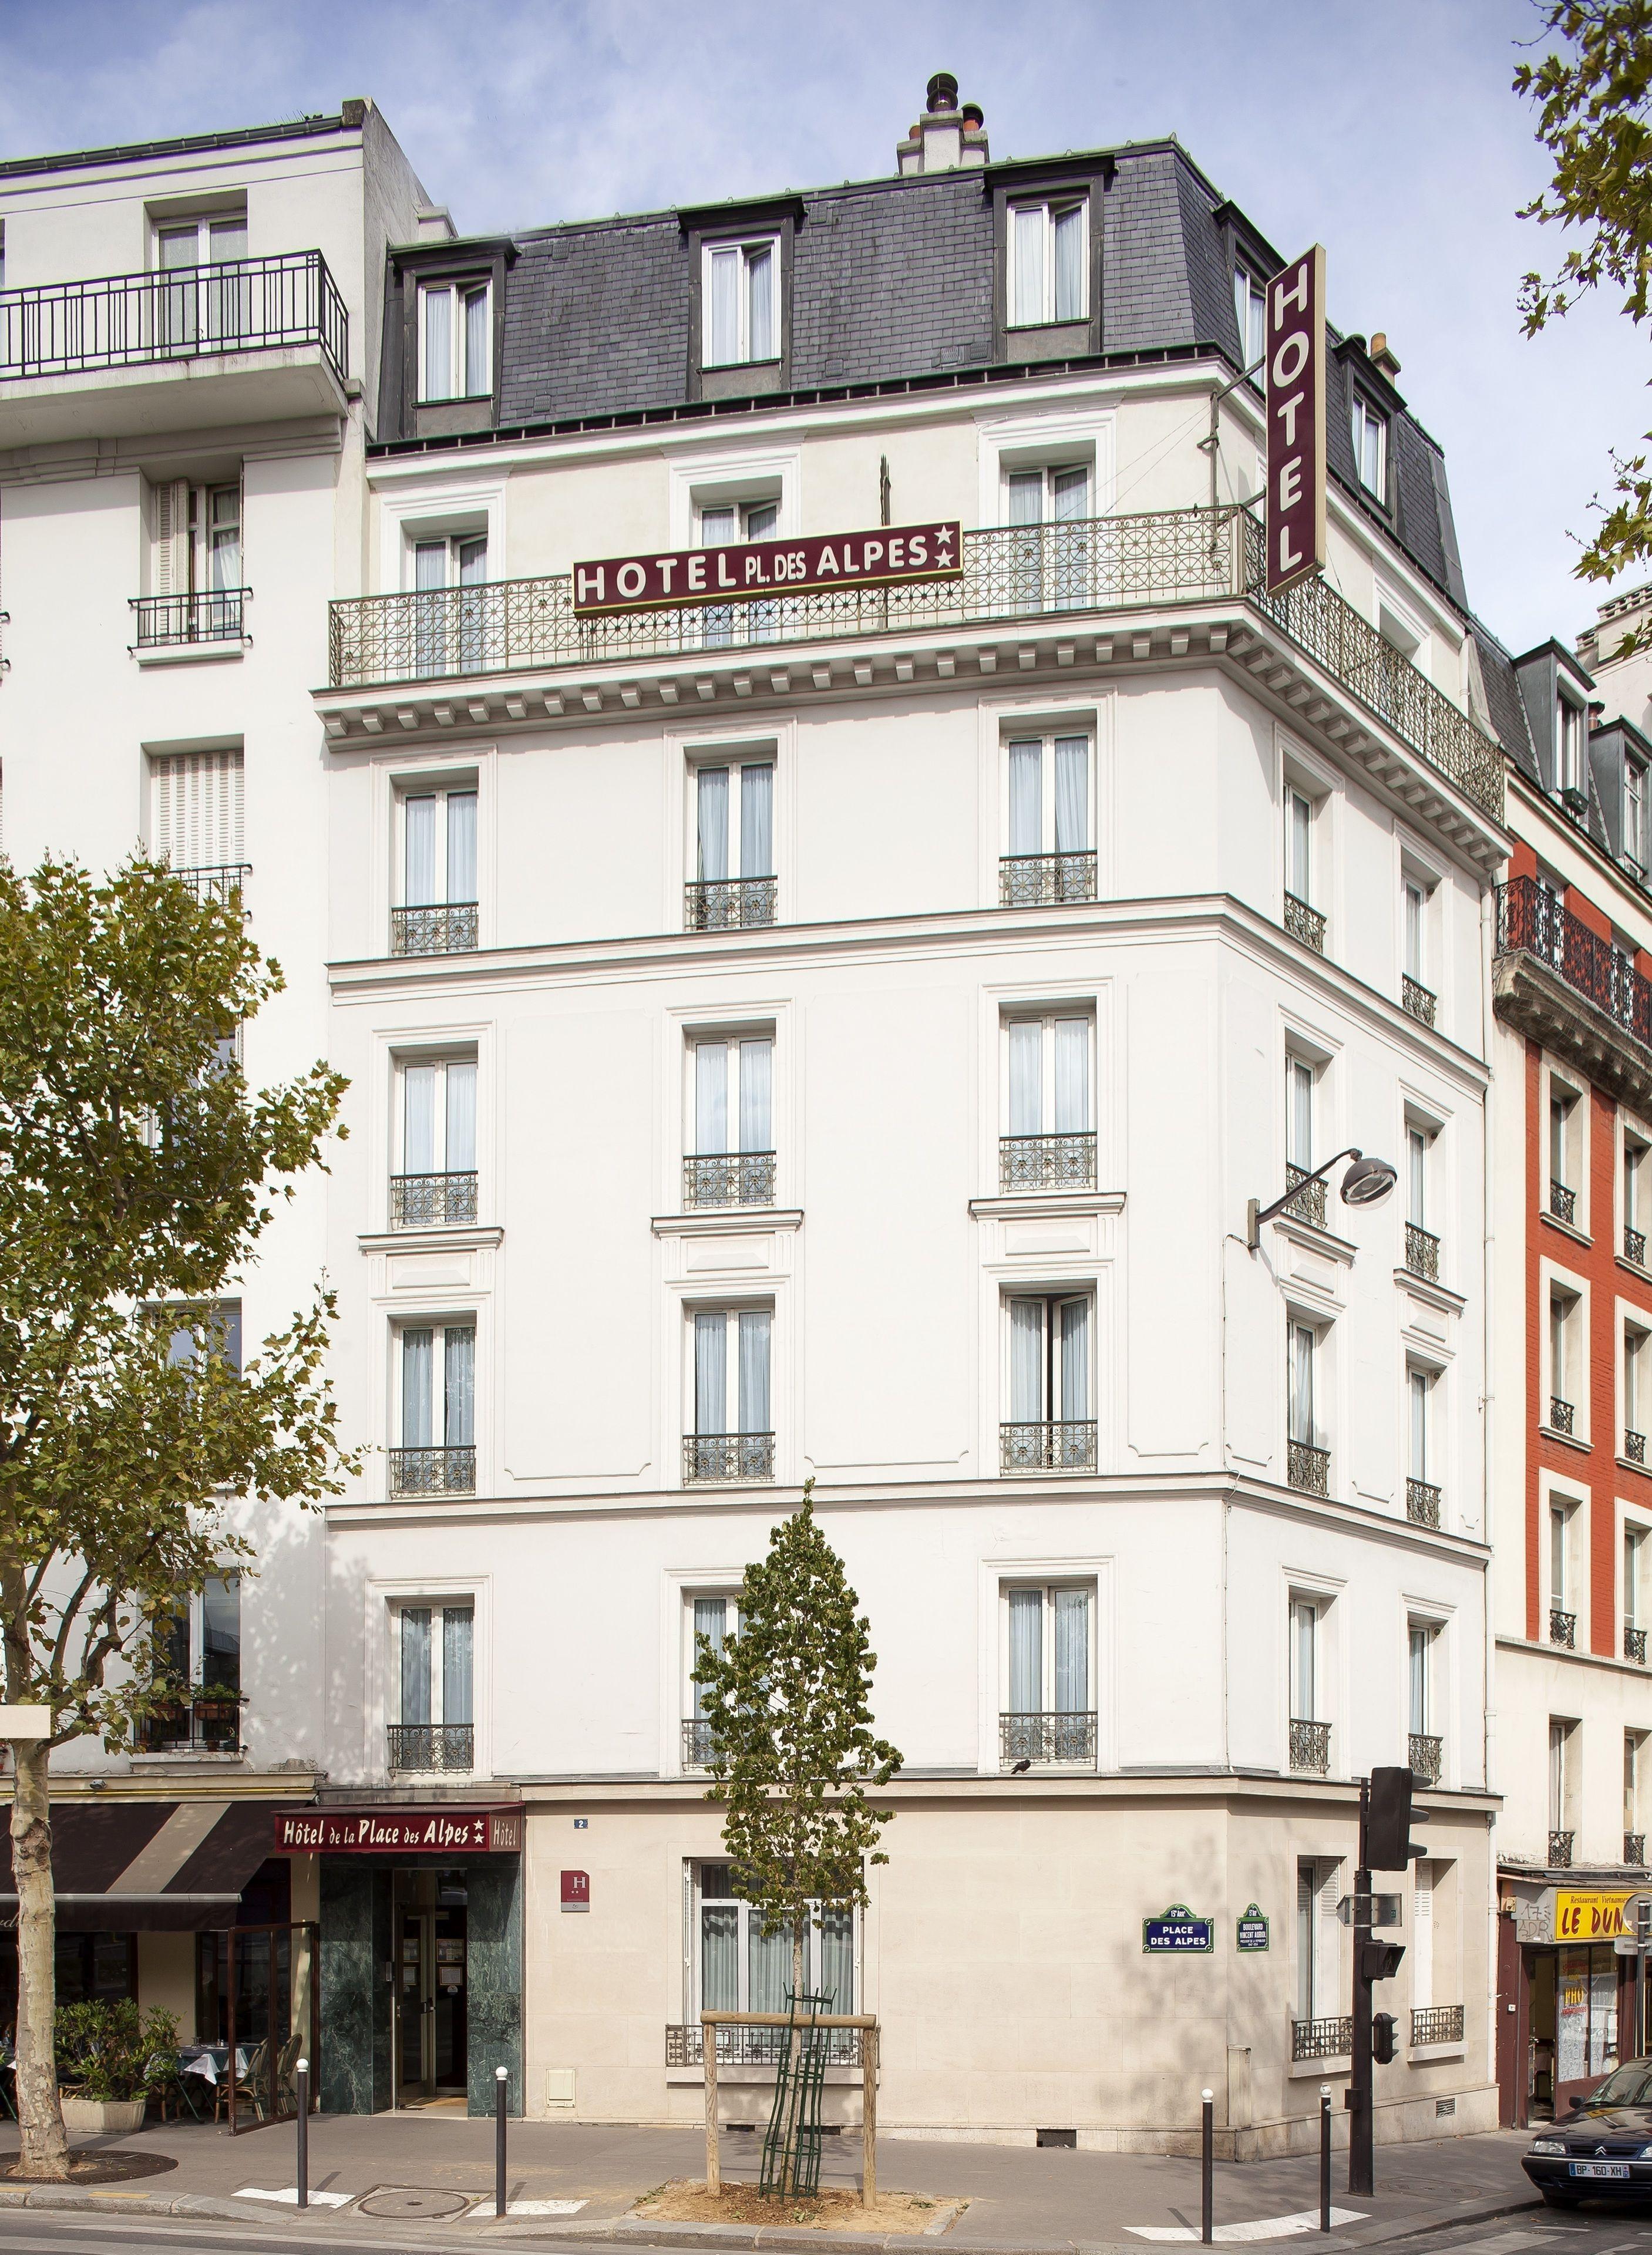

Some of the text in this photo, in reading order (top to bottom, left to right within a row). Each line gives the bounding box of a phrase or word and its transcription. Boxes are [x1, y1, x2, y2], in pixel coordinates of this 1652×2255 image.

[1273, 263, 1309, 574] HOTEL
[578, 535, 928, 603] HOTEL PL. DES ALPES
[283, 1819, 468, 1846] Hôtel de la Place des Alpes
[493, 1819, 516, 1846] Hôtel
[573, 1877, 586, 1888] H
[1562, 1907, 1634, 1935] LE DUN
[1577, 2166, 1621, 2176] BP-160-XH
